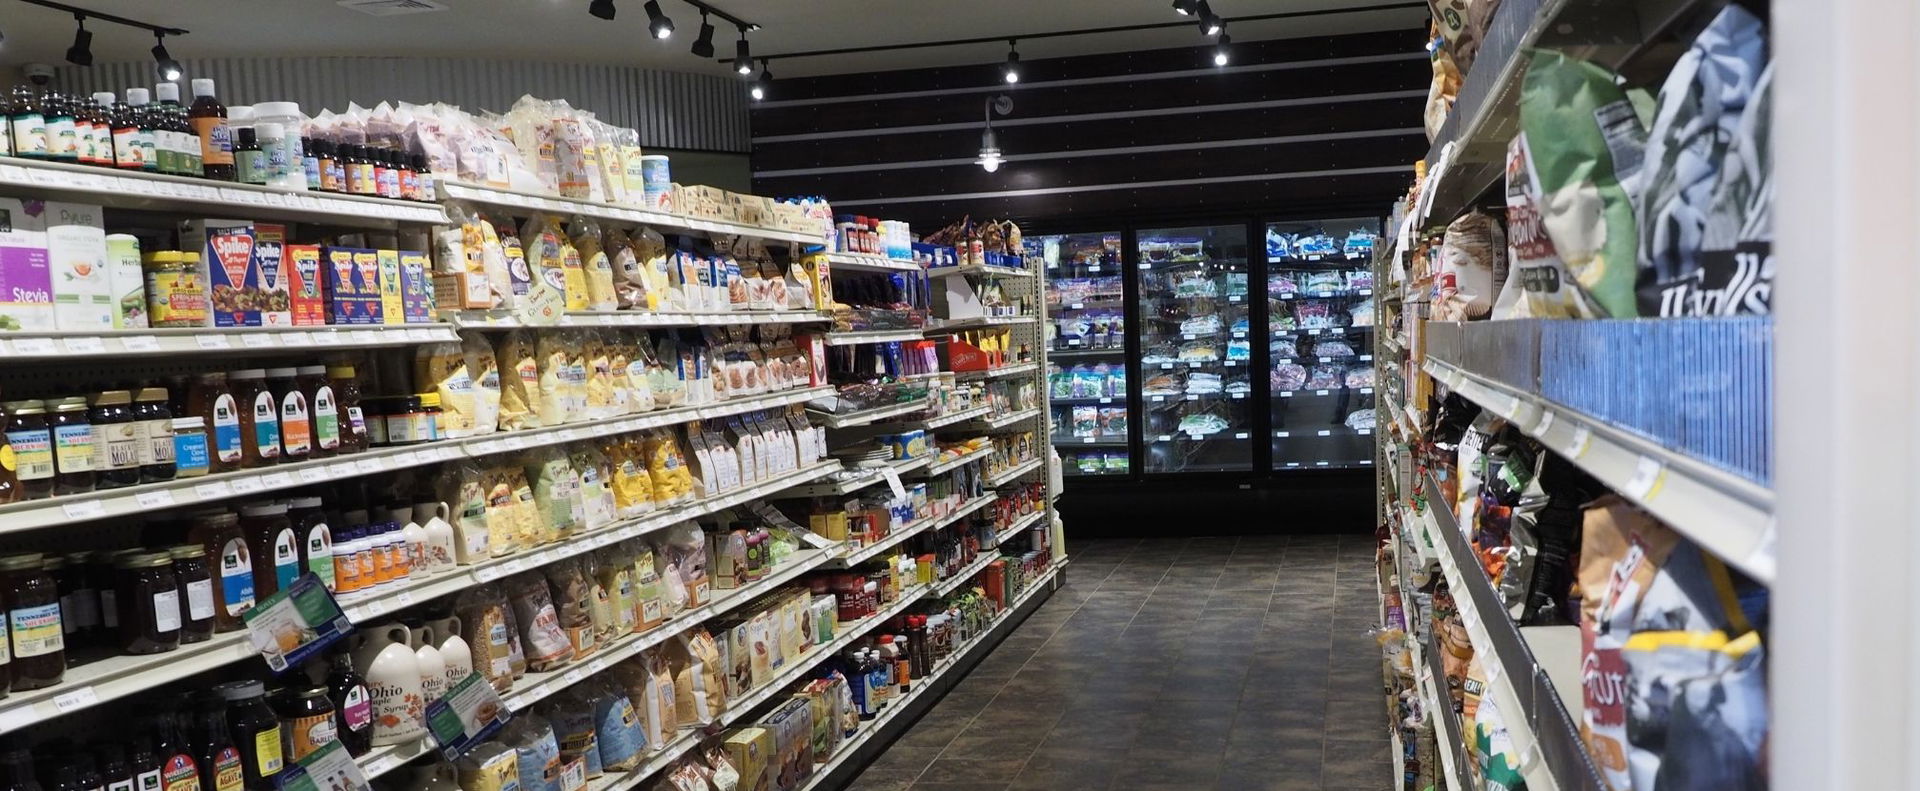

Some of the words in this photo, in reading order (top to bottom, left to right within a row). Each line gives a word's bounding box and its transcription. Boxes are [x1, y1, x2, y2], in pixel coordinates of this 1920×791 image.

[60, 209, 92, 225] Pyure
[217, 238, 249, 258] Spike
[12, 287, 49, 304] Stevia
[370, 684, 403, 699] Ohio
[220, 772, 239, 786] AGAVE
